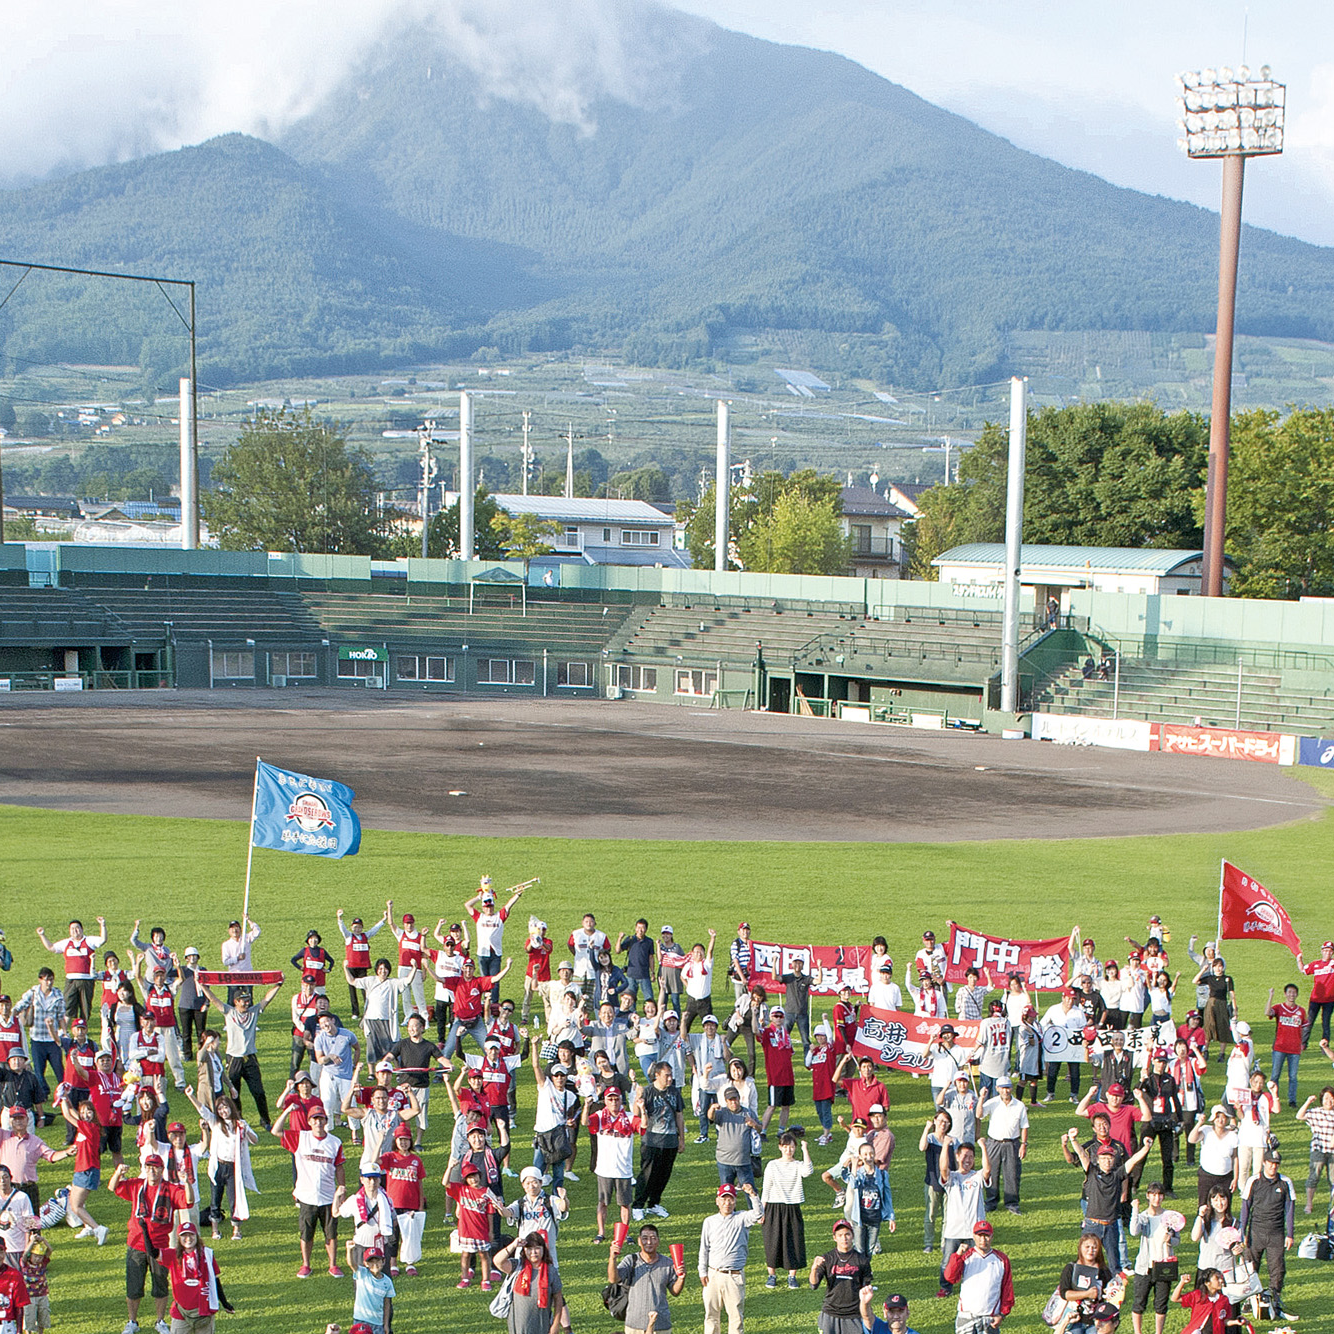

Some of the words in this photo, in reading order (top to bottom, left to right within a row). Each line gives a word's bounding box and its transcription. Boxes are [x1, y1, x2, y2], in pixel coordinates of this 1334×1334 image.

[835, 948, 845, 966] 2
[952, 928, 1021, 973] 門中
[863, 1017, 908, 1044] 高井
[992, 1031, 1007, 1047] 16
